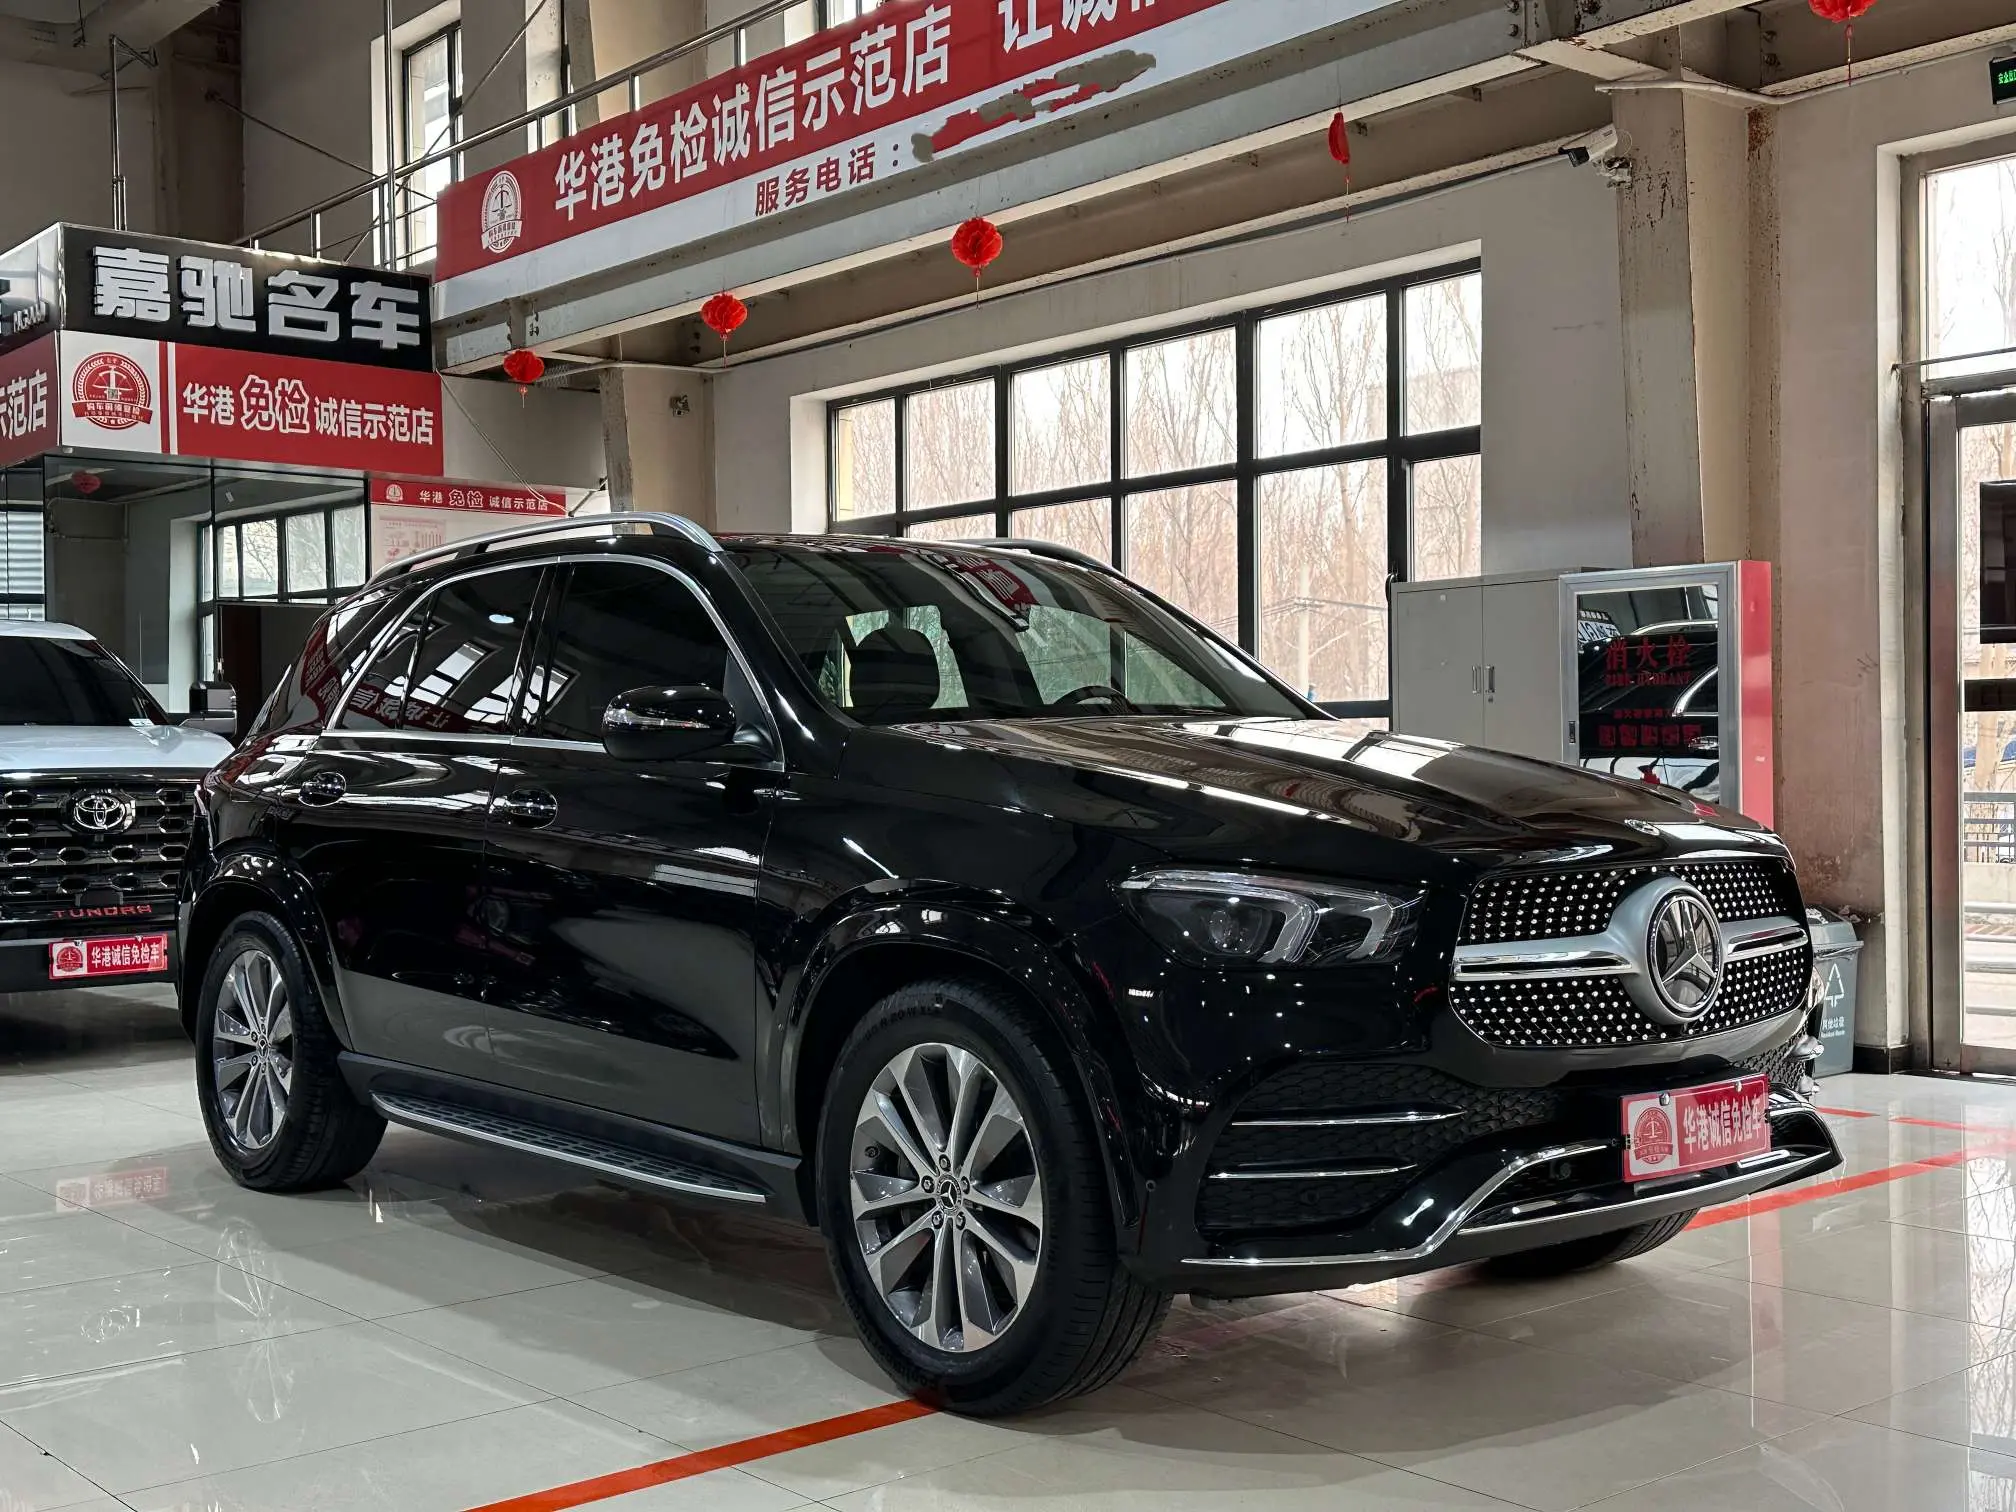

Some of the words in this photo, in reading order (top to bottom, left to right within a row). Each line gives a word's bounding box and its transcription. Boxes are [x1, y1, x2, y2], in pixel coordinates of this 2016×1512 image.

[554, 4, 952, 220] 华港免检诚信示范店
[93, 246, 420, 349] 嘉驰名车
[54, 904, 152, 918] TUNDRA
[91, 942, 160, 968] 华港诚信免检车
[1683, 1093, 1762, 1153] 华港诚信免检车
